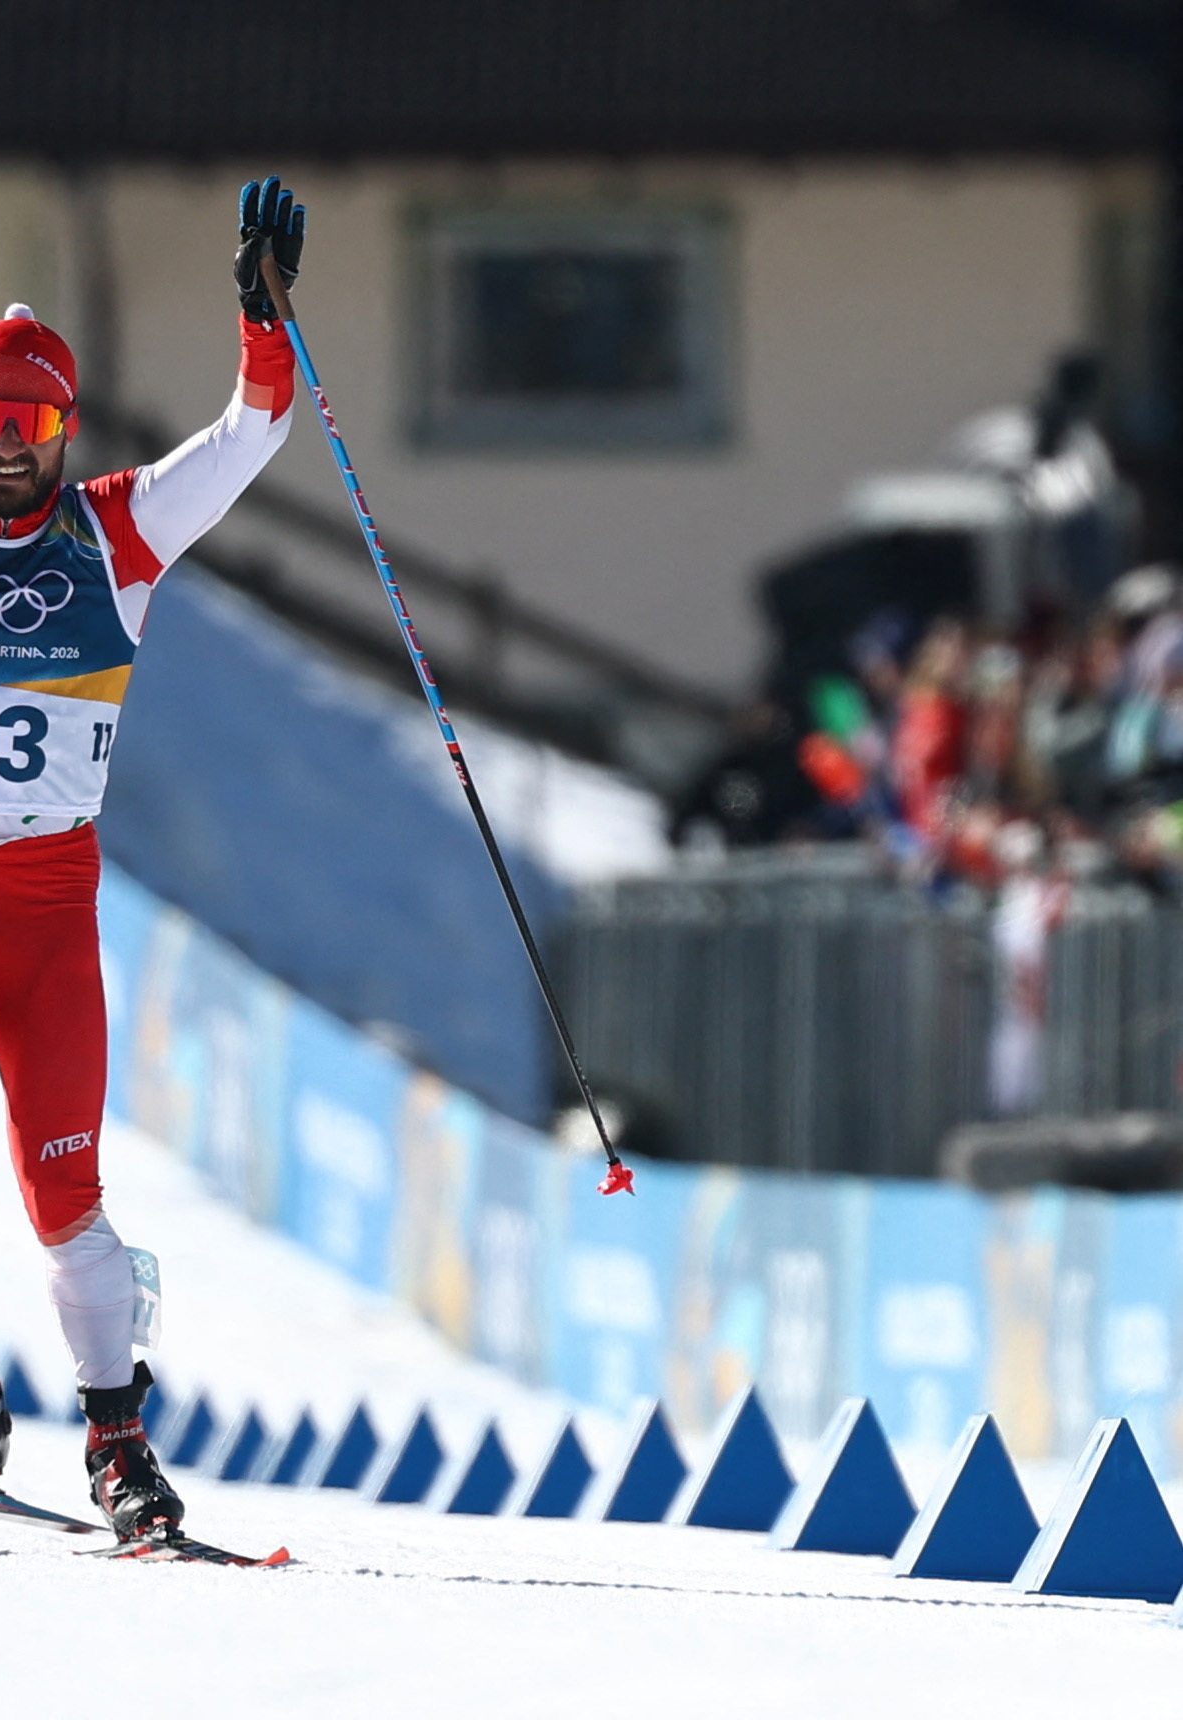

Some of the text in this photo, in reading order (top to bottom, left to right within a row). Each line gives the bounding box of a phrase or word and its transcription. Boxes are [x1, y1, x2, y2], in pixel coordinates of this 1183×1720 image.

[25, 352, 73, 402] LEBANON
[49, 646, 80, 659] 2026
[39, 1129, 94, 1162] ATEX
